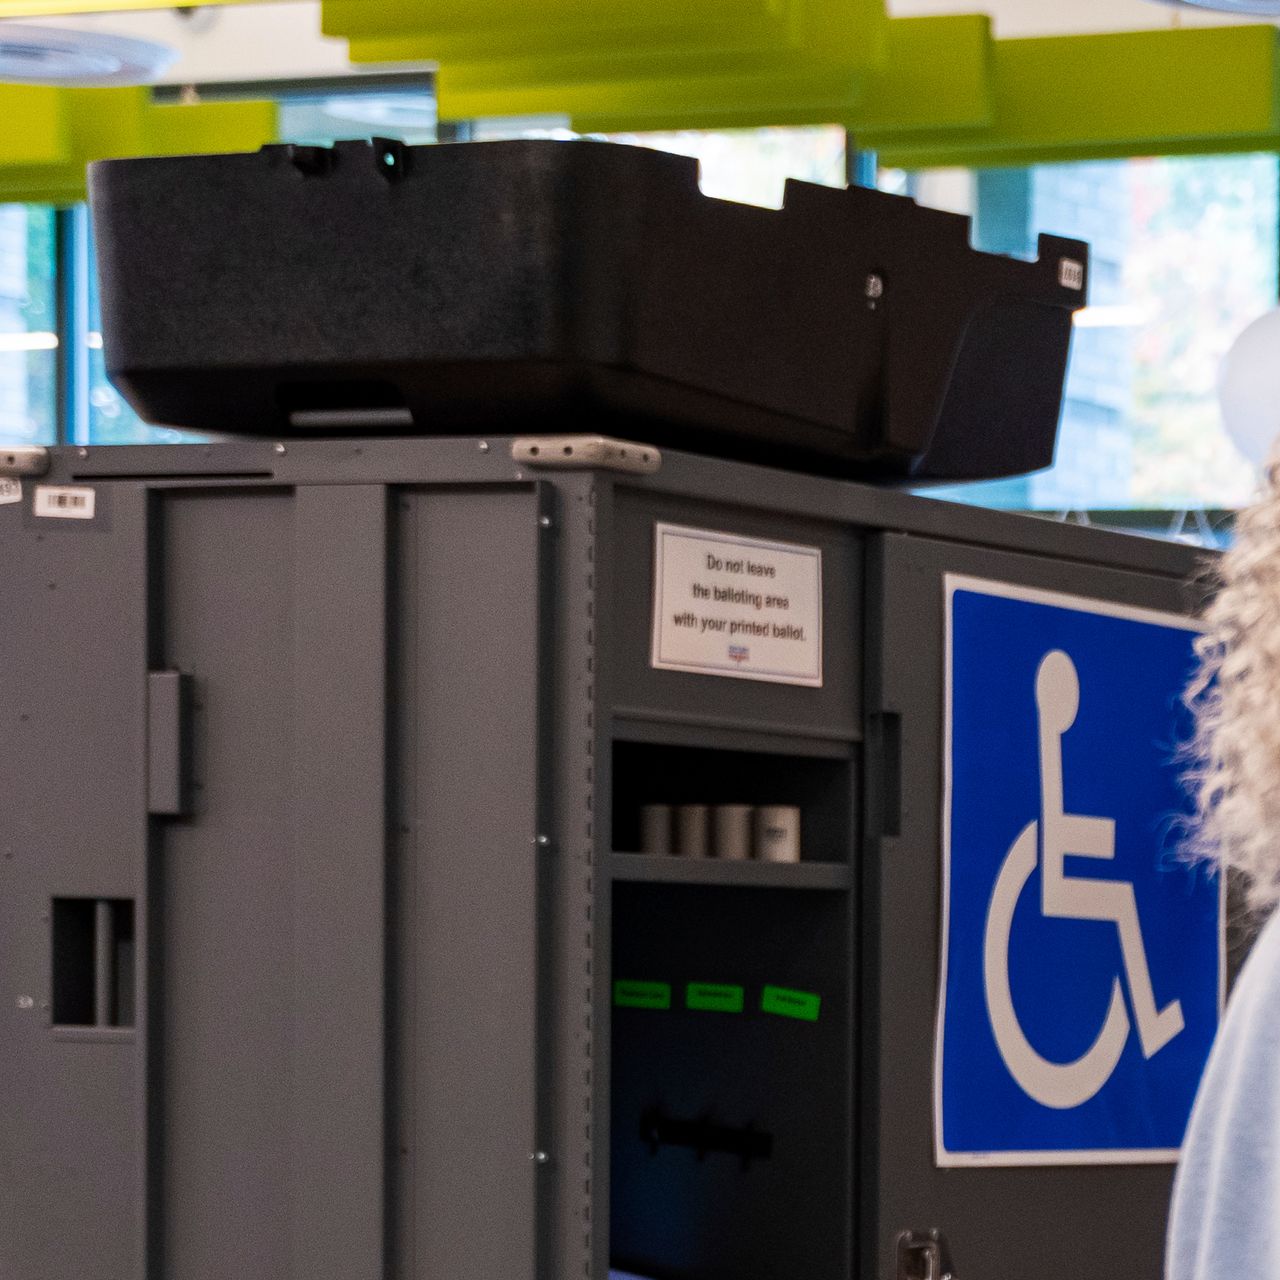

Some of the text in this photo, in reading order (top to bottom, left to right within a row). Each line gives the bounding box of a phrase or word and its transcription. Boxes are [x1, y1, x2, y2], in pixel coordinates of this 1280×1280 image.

[706, 554, 776, 579] Do not leave
[692, 582, 789, 610] the balloting area
[673, 611, 697, 628] with
[701, 617, 726, 633] your
[729, 619, 769, 636] printed
